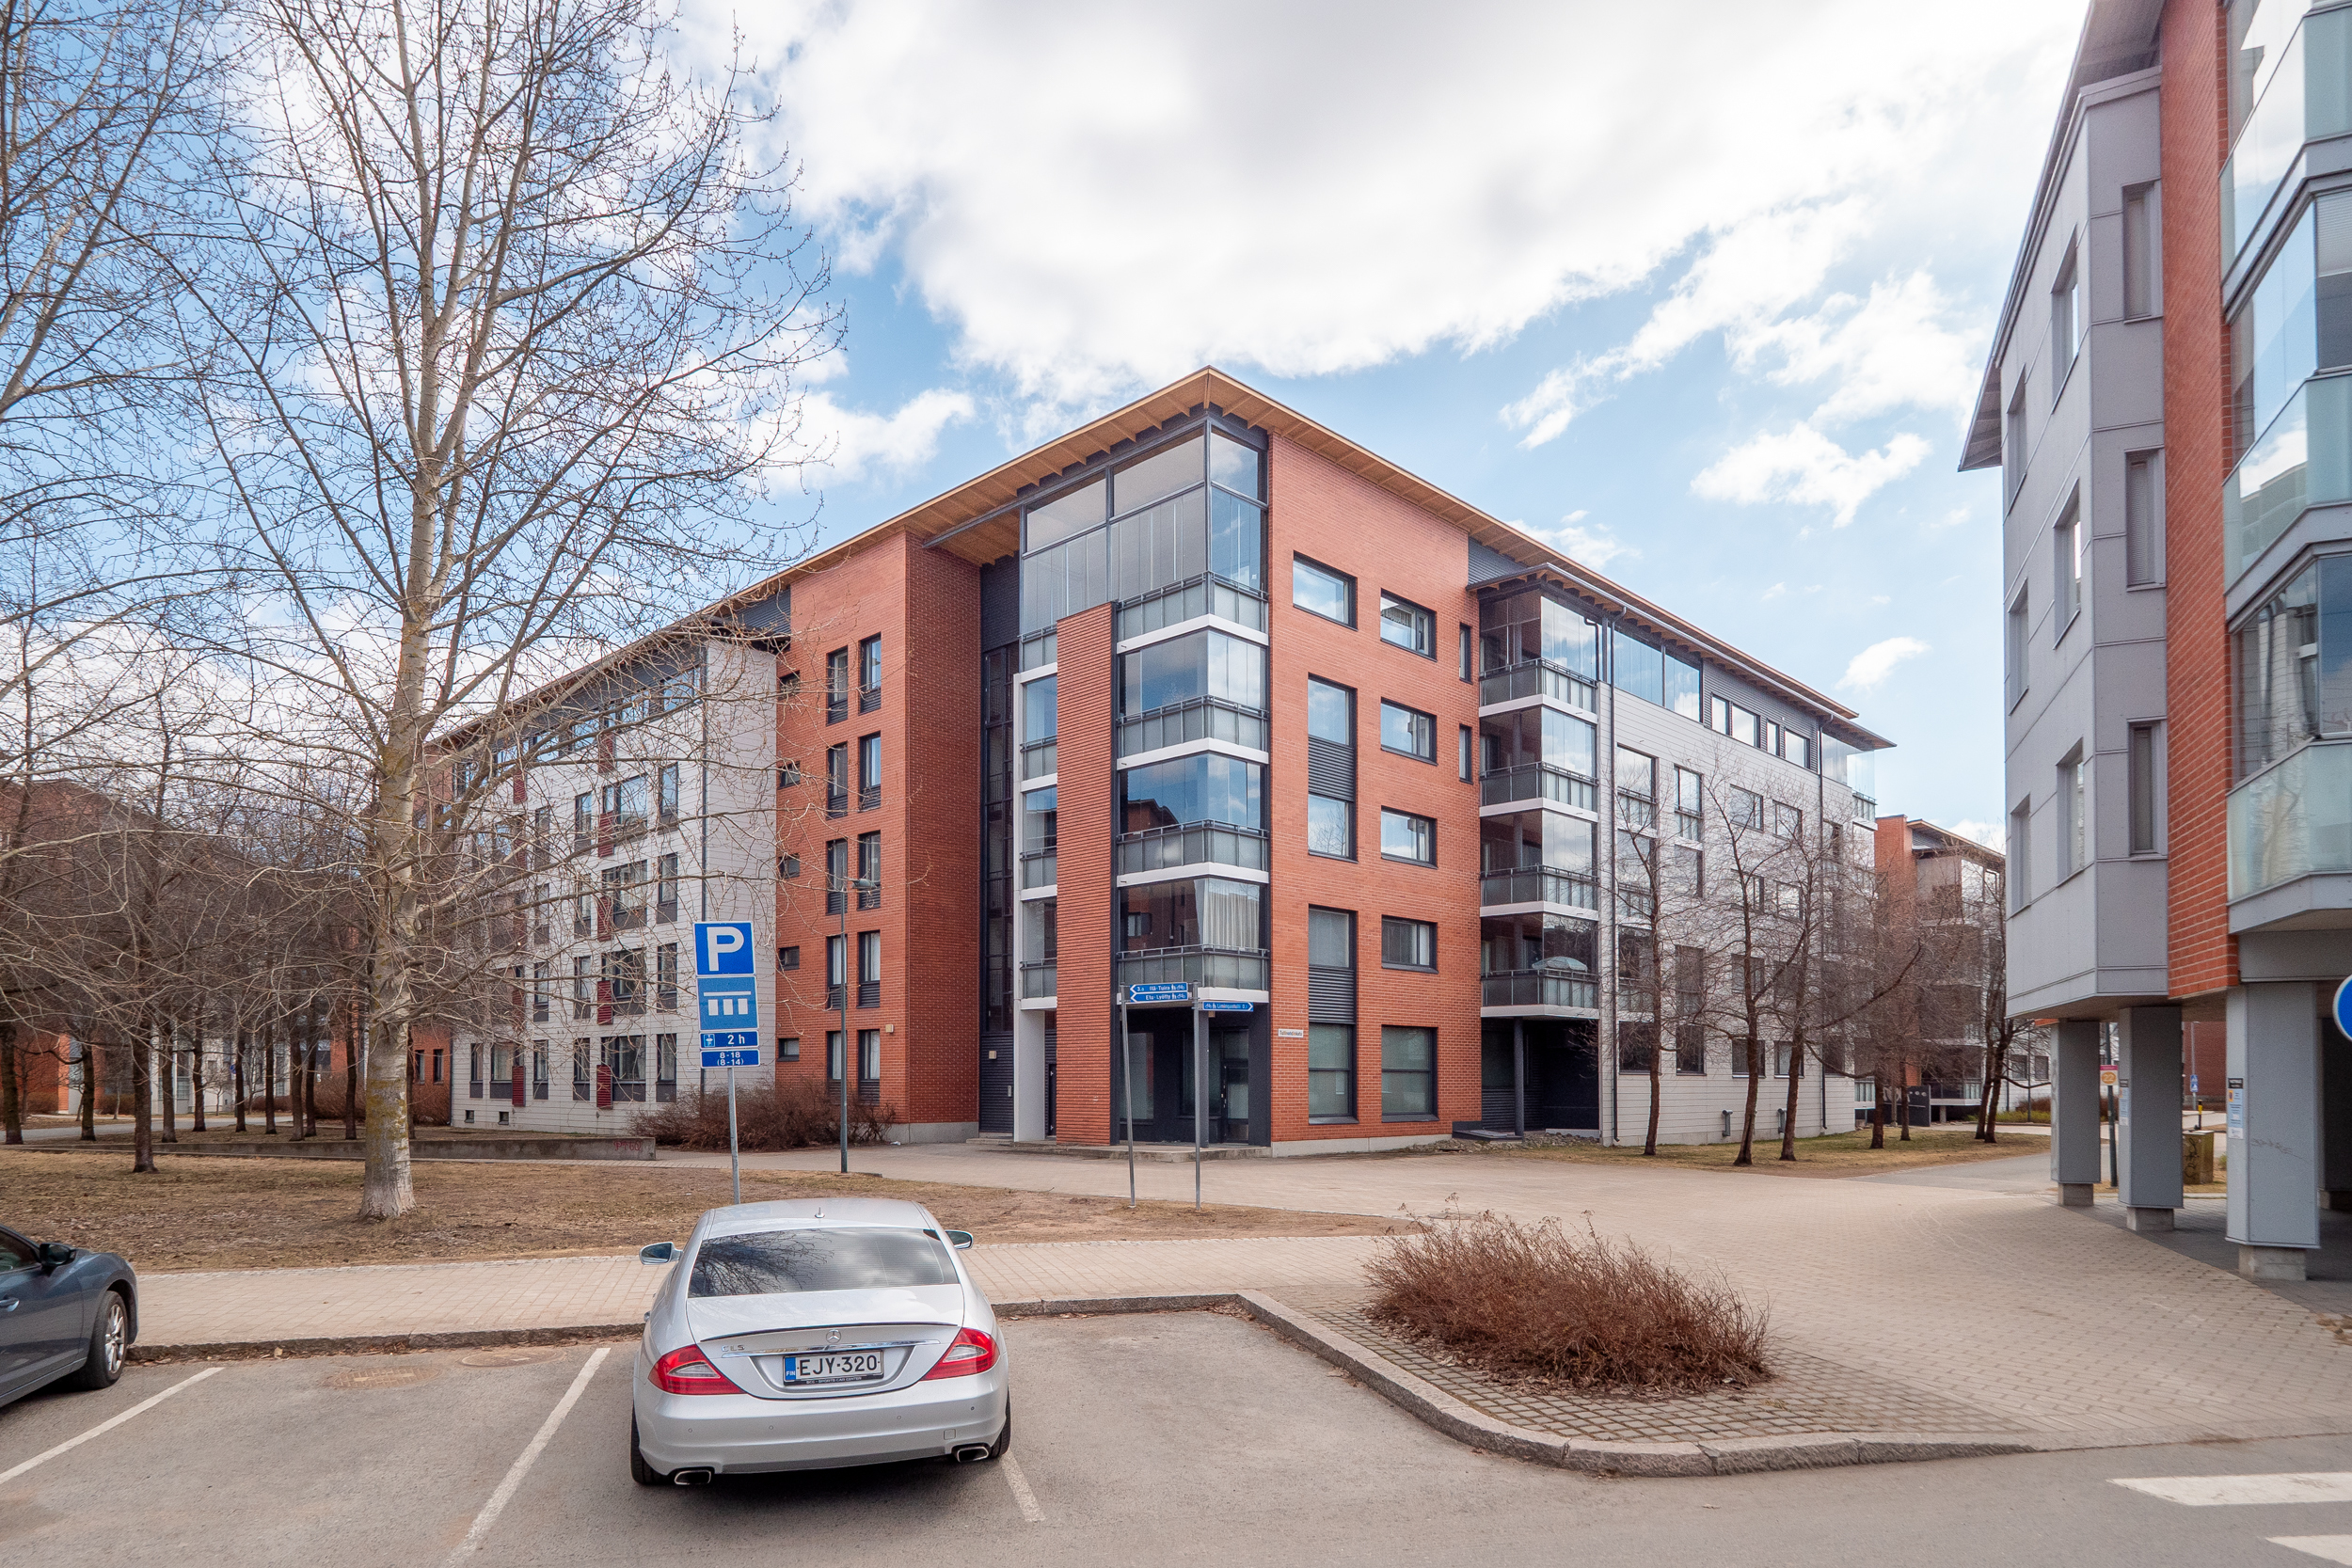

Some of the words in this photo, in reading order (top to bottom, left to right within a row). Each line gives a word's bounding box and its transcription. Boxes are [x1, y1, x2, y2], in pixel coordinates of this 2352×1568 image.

[707, 927, 744, 971] P
[727, 1035, 735, 1045] 2
[739, 1034, 745, 1044] h
[2103, 1073, 2114, 1082] 22
